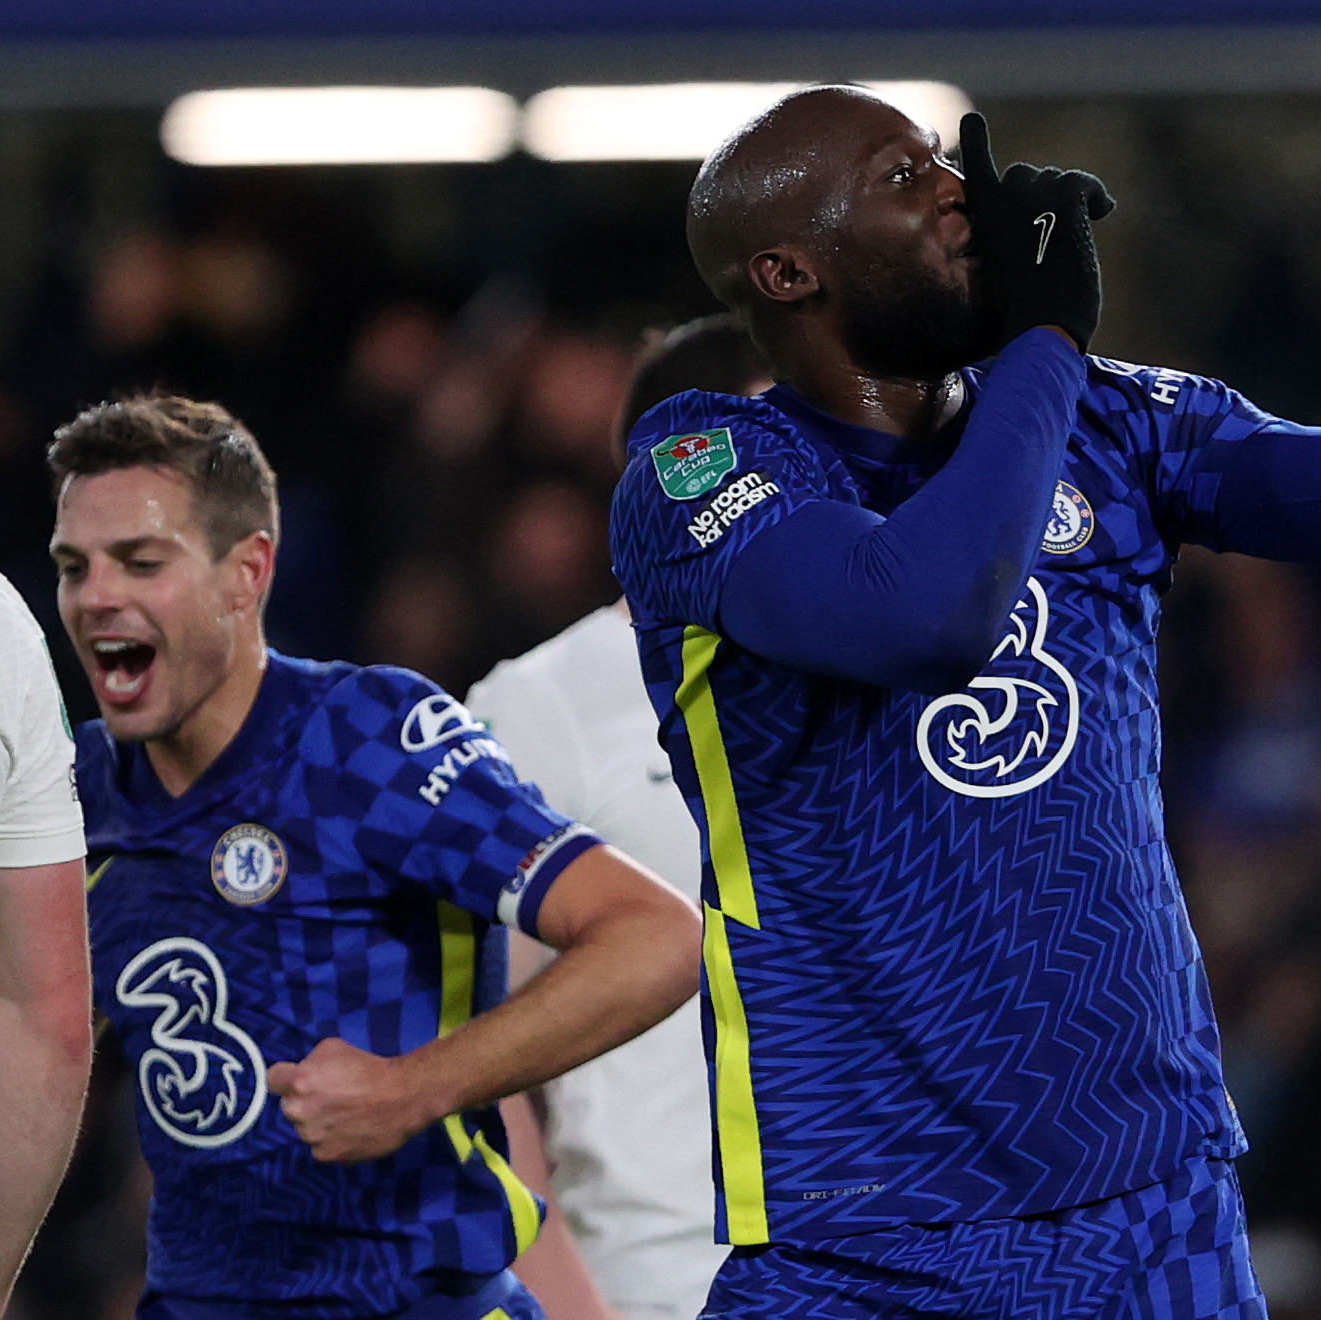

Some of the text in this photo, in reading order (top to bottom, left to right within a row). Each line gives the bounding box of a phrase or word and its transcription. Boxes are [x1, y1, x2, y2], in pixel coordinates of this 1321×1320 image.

[687, 473, 762, 542] No room
[698, 482, 780, 548] for racism
